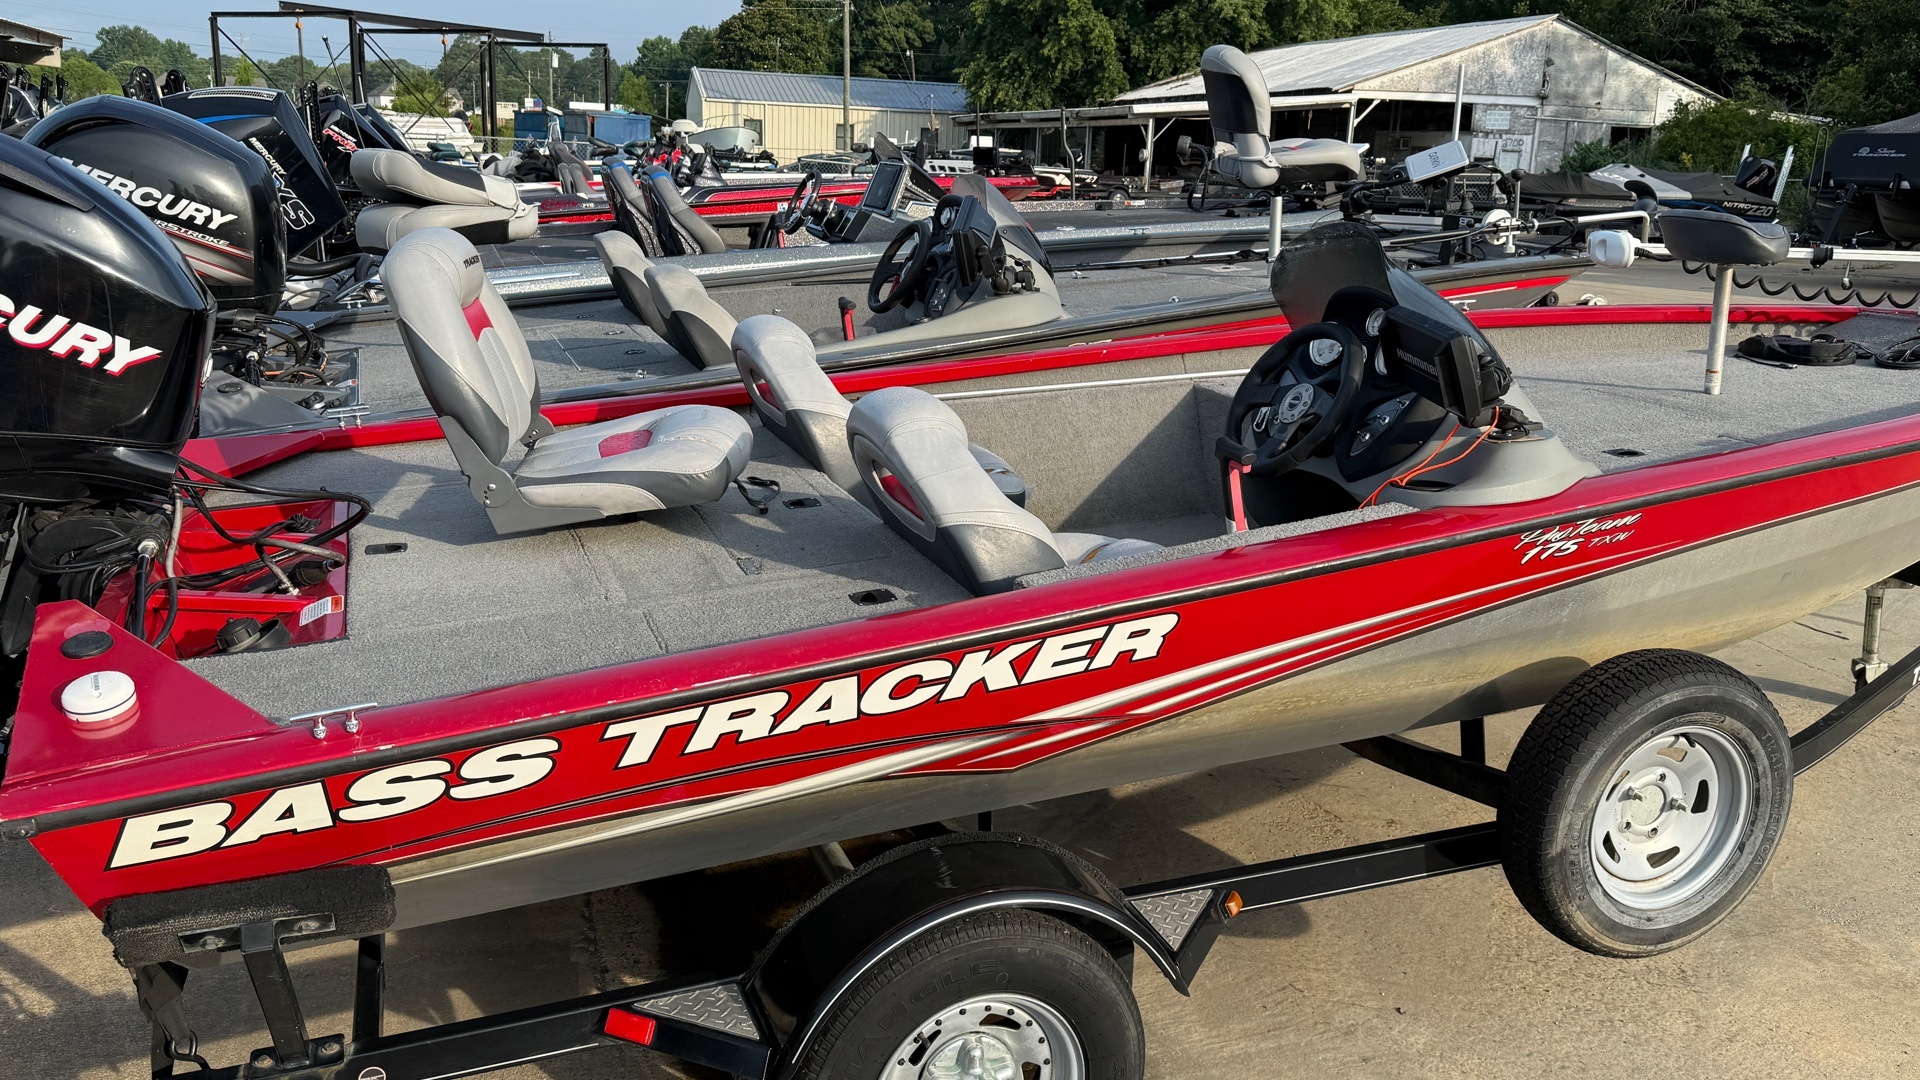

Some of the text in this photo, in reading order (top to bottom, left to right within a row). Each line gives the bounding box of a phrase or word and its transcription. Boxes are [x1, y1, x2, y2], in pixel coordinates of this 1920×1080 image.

[248, 136, 288, 176] MERCURY
[1502, 138, 1525, 148] 2700
[1722, 201, 1774, 217] NITRO Z20
[1520, 538, 1586, 565] 175
[104, 612, 1181, 873] BASS TRACKER
[1753, 730, 1785, 866] TRAIL AMERICA
